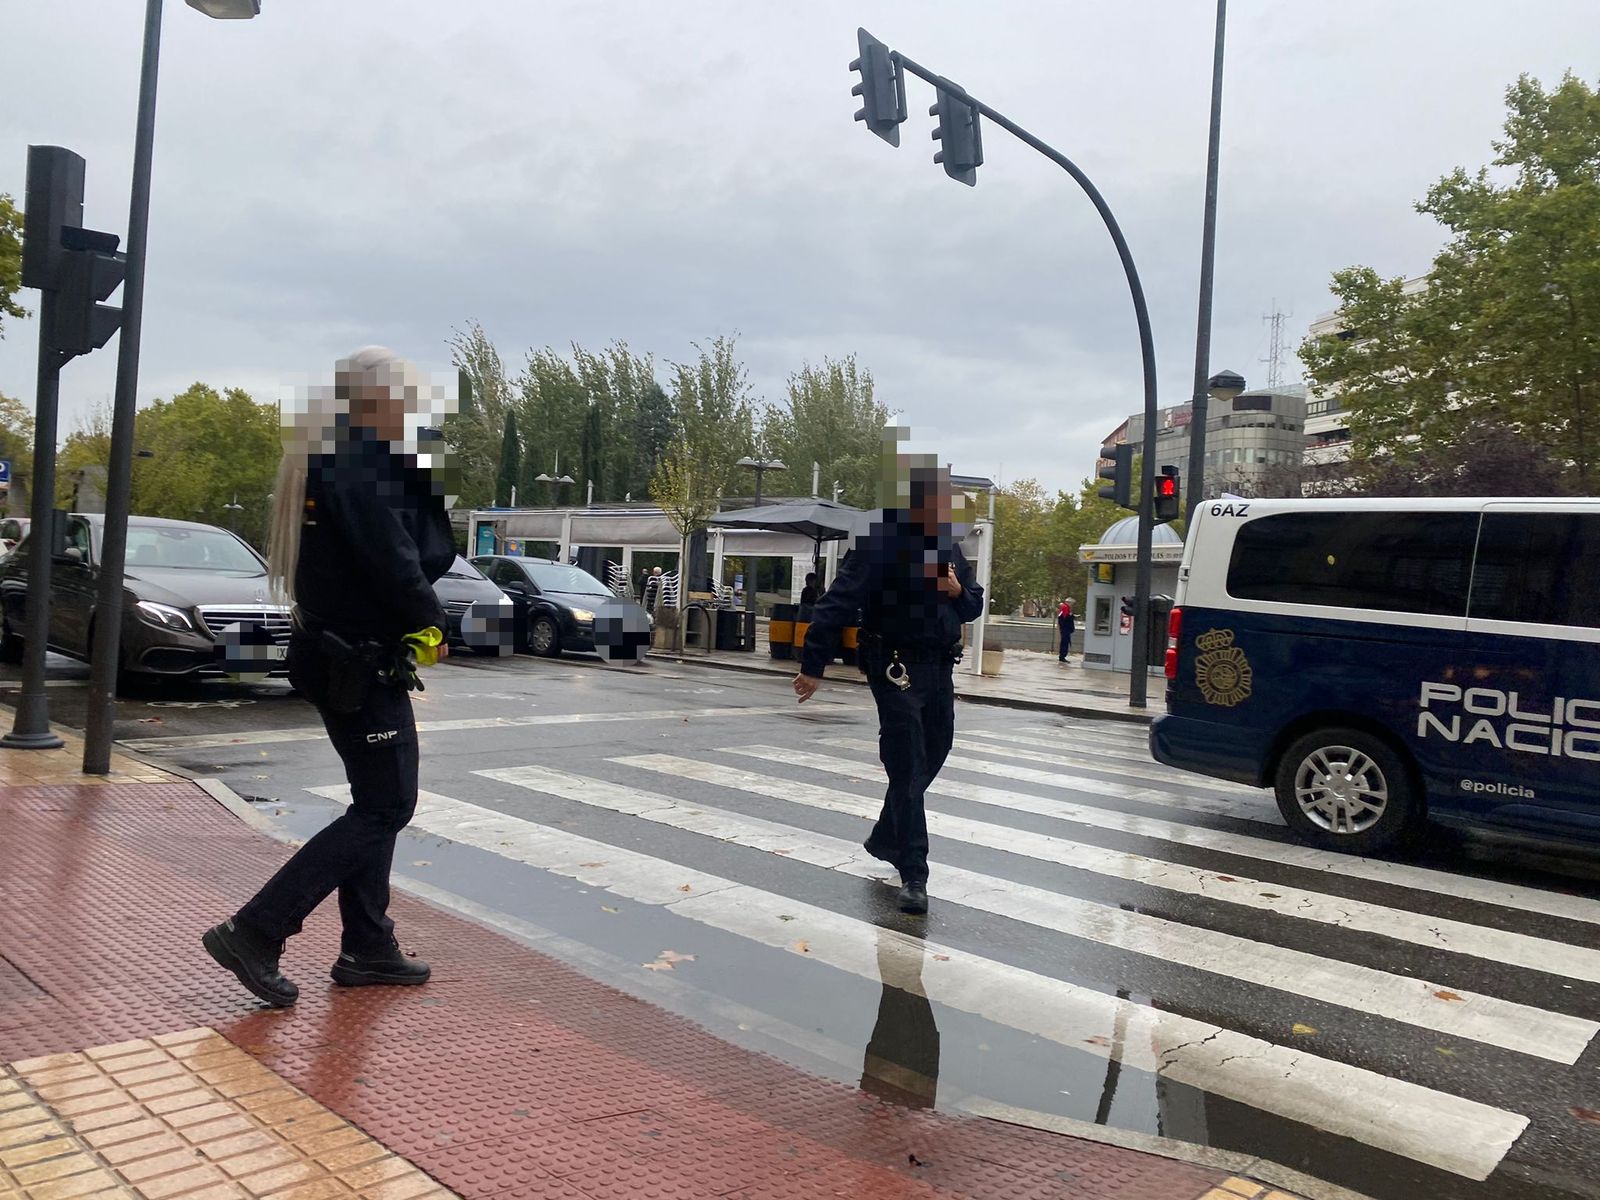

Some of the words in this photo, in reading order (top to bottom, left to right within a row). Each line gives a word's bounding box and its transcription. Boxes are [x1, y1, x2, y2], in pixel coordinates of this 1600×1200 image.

[1211, 503, 1250, 517] 6AZ
[1420, 681, 1600, 729] POLIC
[366, 730, 397, 743] CNP
[1460, 779, 1535, 798] @policia
